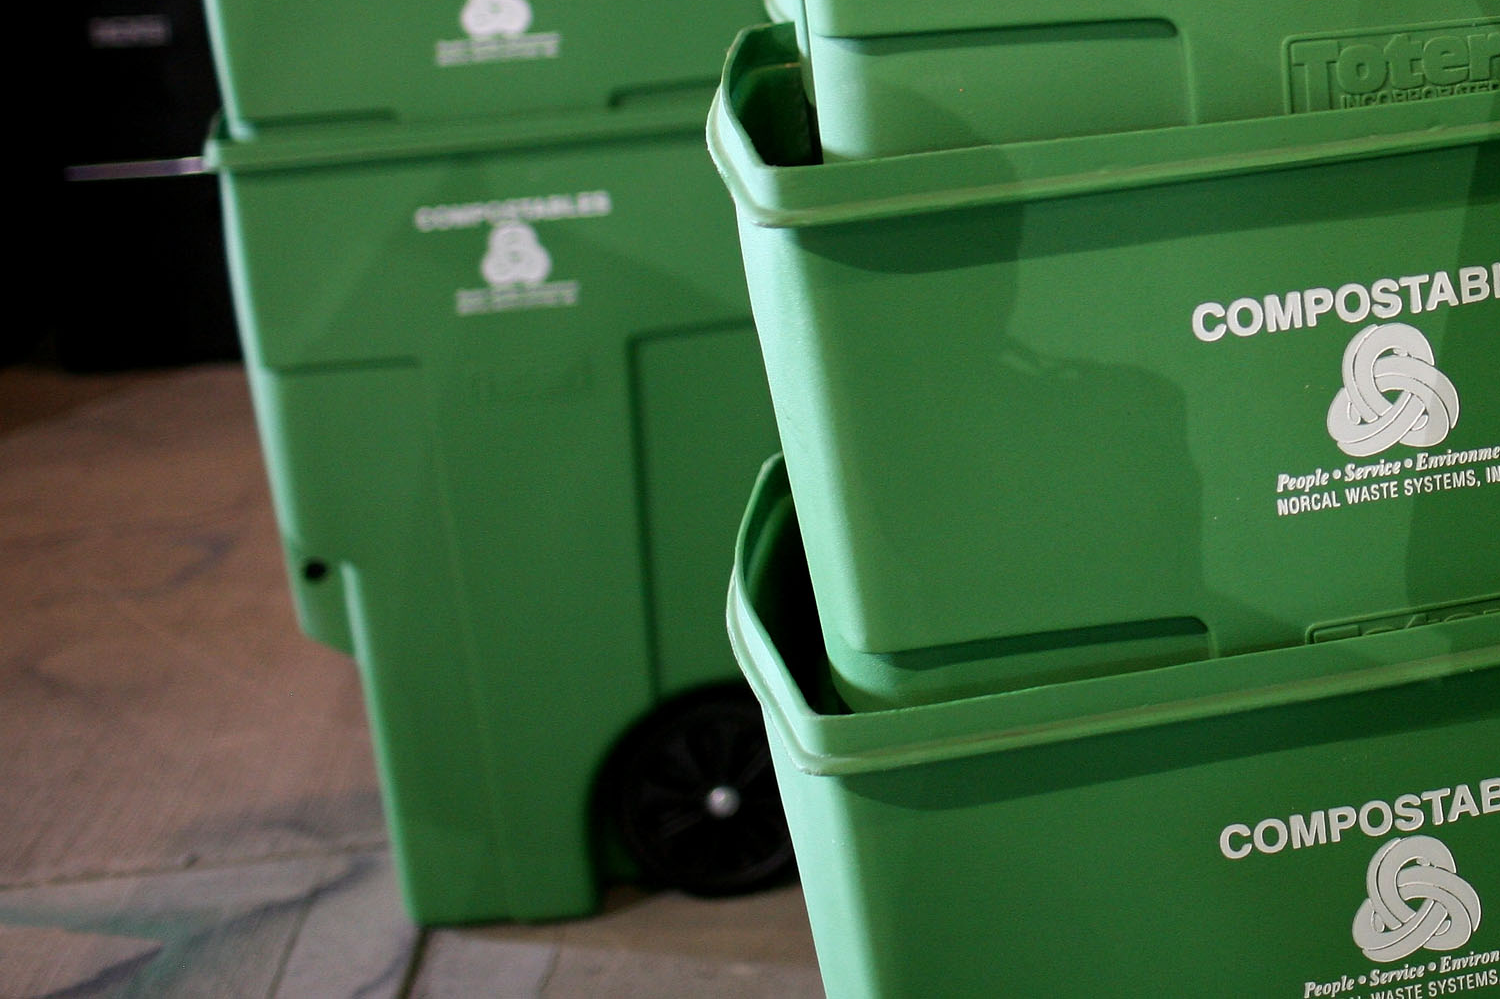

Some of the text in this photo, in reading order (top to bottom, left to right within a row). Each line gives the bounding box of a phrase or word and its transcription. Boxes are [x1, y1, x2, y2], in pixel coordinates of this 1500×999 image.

[1276, 468, 1330, 493] People
[1343, 458, 1402, 482] Service
[1277, 490, 1342, 516] NORCAL
[1344, 481, 1400, 505] WASTE
[1403, 470, 1481, 496] SYSTEMS,
[1303, 974, 1355, 999] People
[1369, 963, 1426, 986] Service
